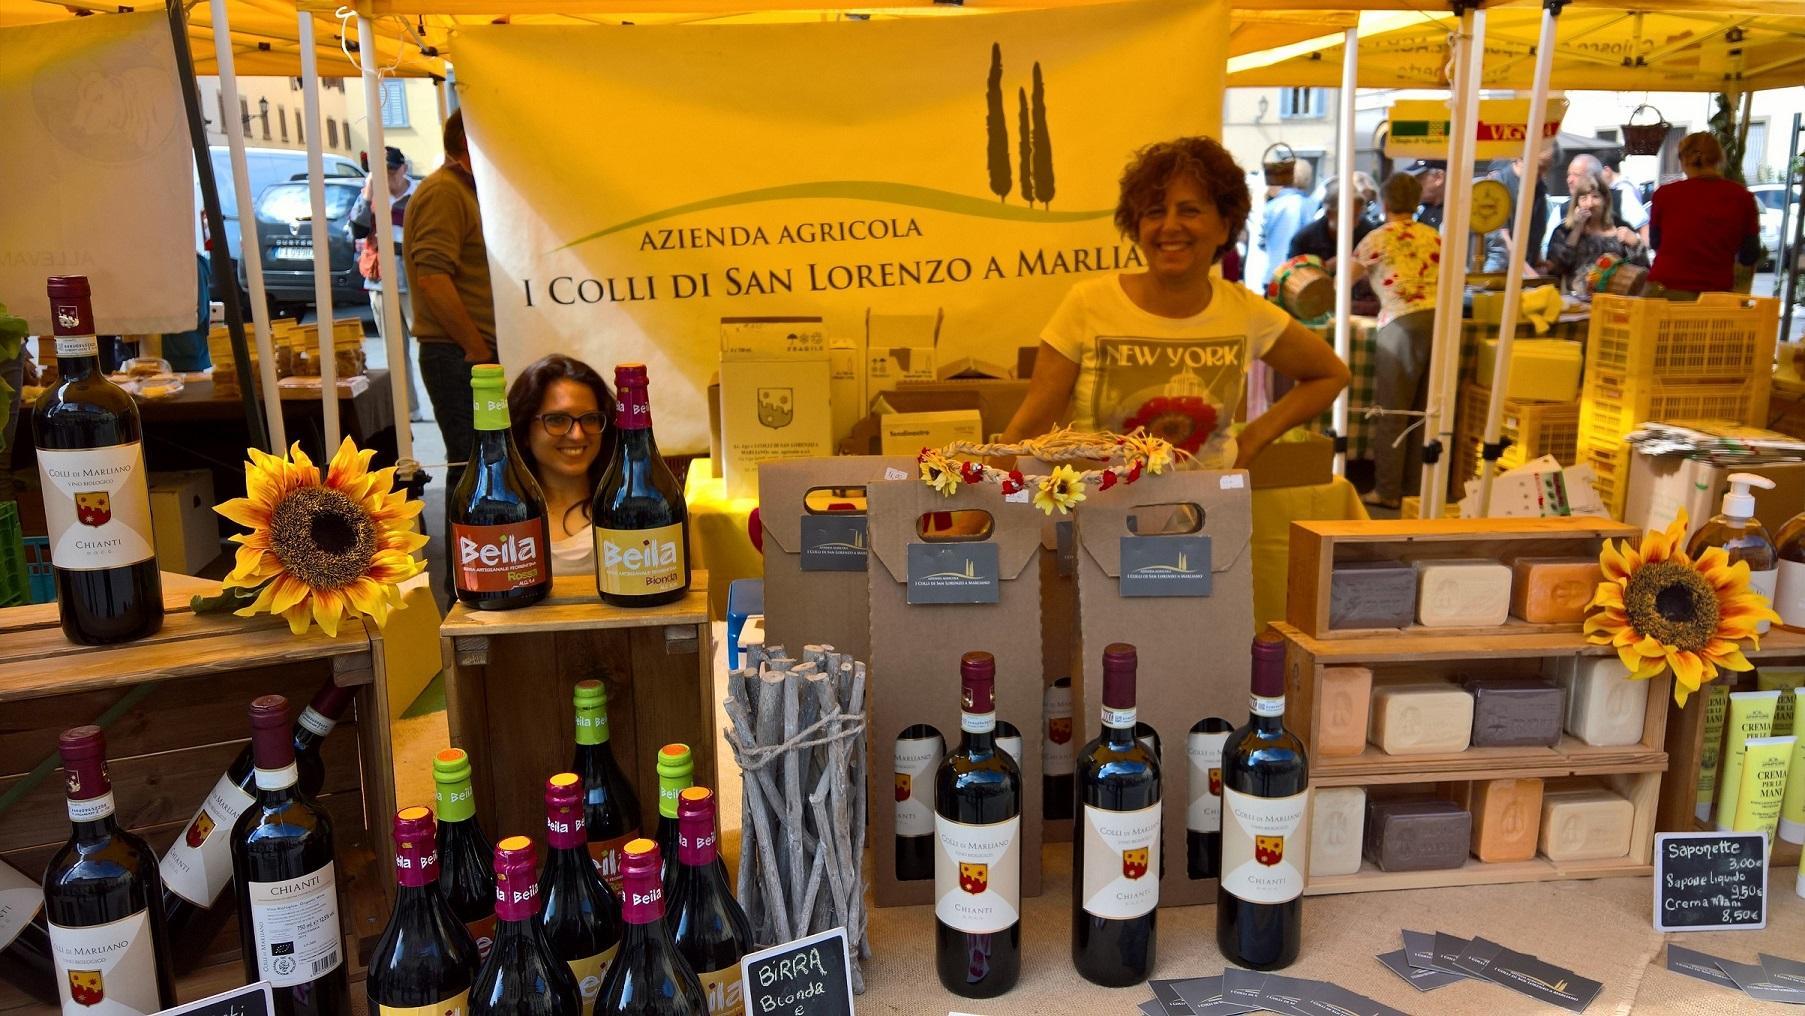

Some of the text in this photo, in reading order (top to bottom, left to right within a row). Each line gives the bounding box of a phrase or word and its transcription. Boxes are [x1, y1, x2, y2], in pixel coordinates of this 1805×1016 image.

[639, 218, 923, 251] AZIENDA AGRICOLA
[523, 278, 534, 307] I
[549, 273, 657, 305] COLLI
[673, 272, 711, 299] DI
[726, 265, 793, 296] SAN
[809, 258, 972, 293] LORENZO
[983, 255, 1006, 280] A
[1105, 345, 1239, 368] NEW YORK
[83, 465, 131, 481] MARLIANO
[75, 538, 122, 550] CHIANTI
[460, 534, 537, 567] Beila
[603, 538, 677, 571] Beila
[1741, 722, 1771, 735] CREMA
[1757, 770, 1788, 784] CREMA
[1762, 781, 1775, 790] PER
[1760, 788, 1783, 799] MANI
[967, 839, 1009, 851] MARLIANO
[1668, 840, 1741, 860] Saponette
[270, 875, 320, 896] CHIANTI
[1248, 875, 1286, 888] CHIANTI
[1666, 873, 1707, 891] Sapone
[514, 881, 539, 904] Beila
[633, 888, 662, 907] Beila
[954, 903, 993, 915] CHIANTI
[1665, 898, 1709, 912] Crema
[74, 939, 129, 957] MARLIANO
